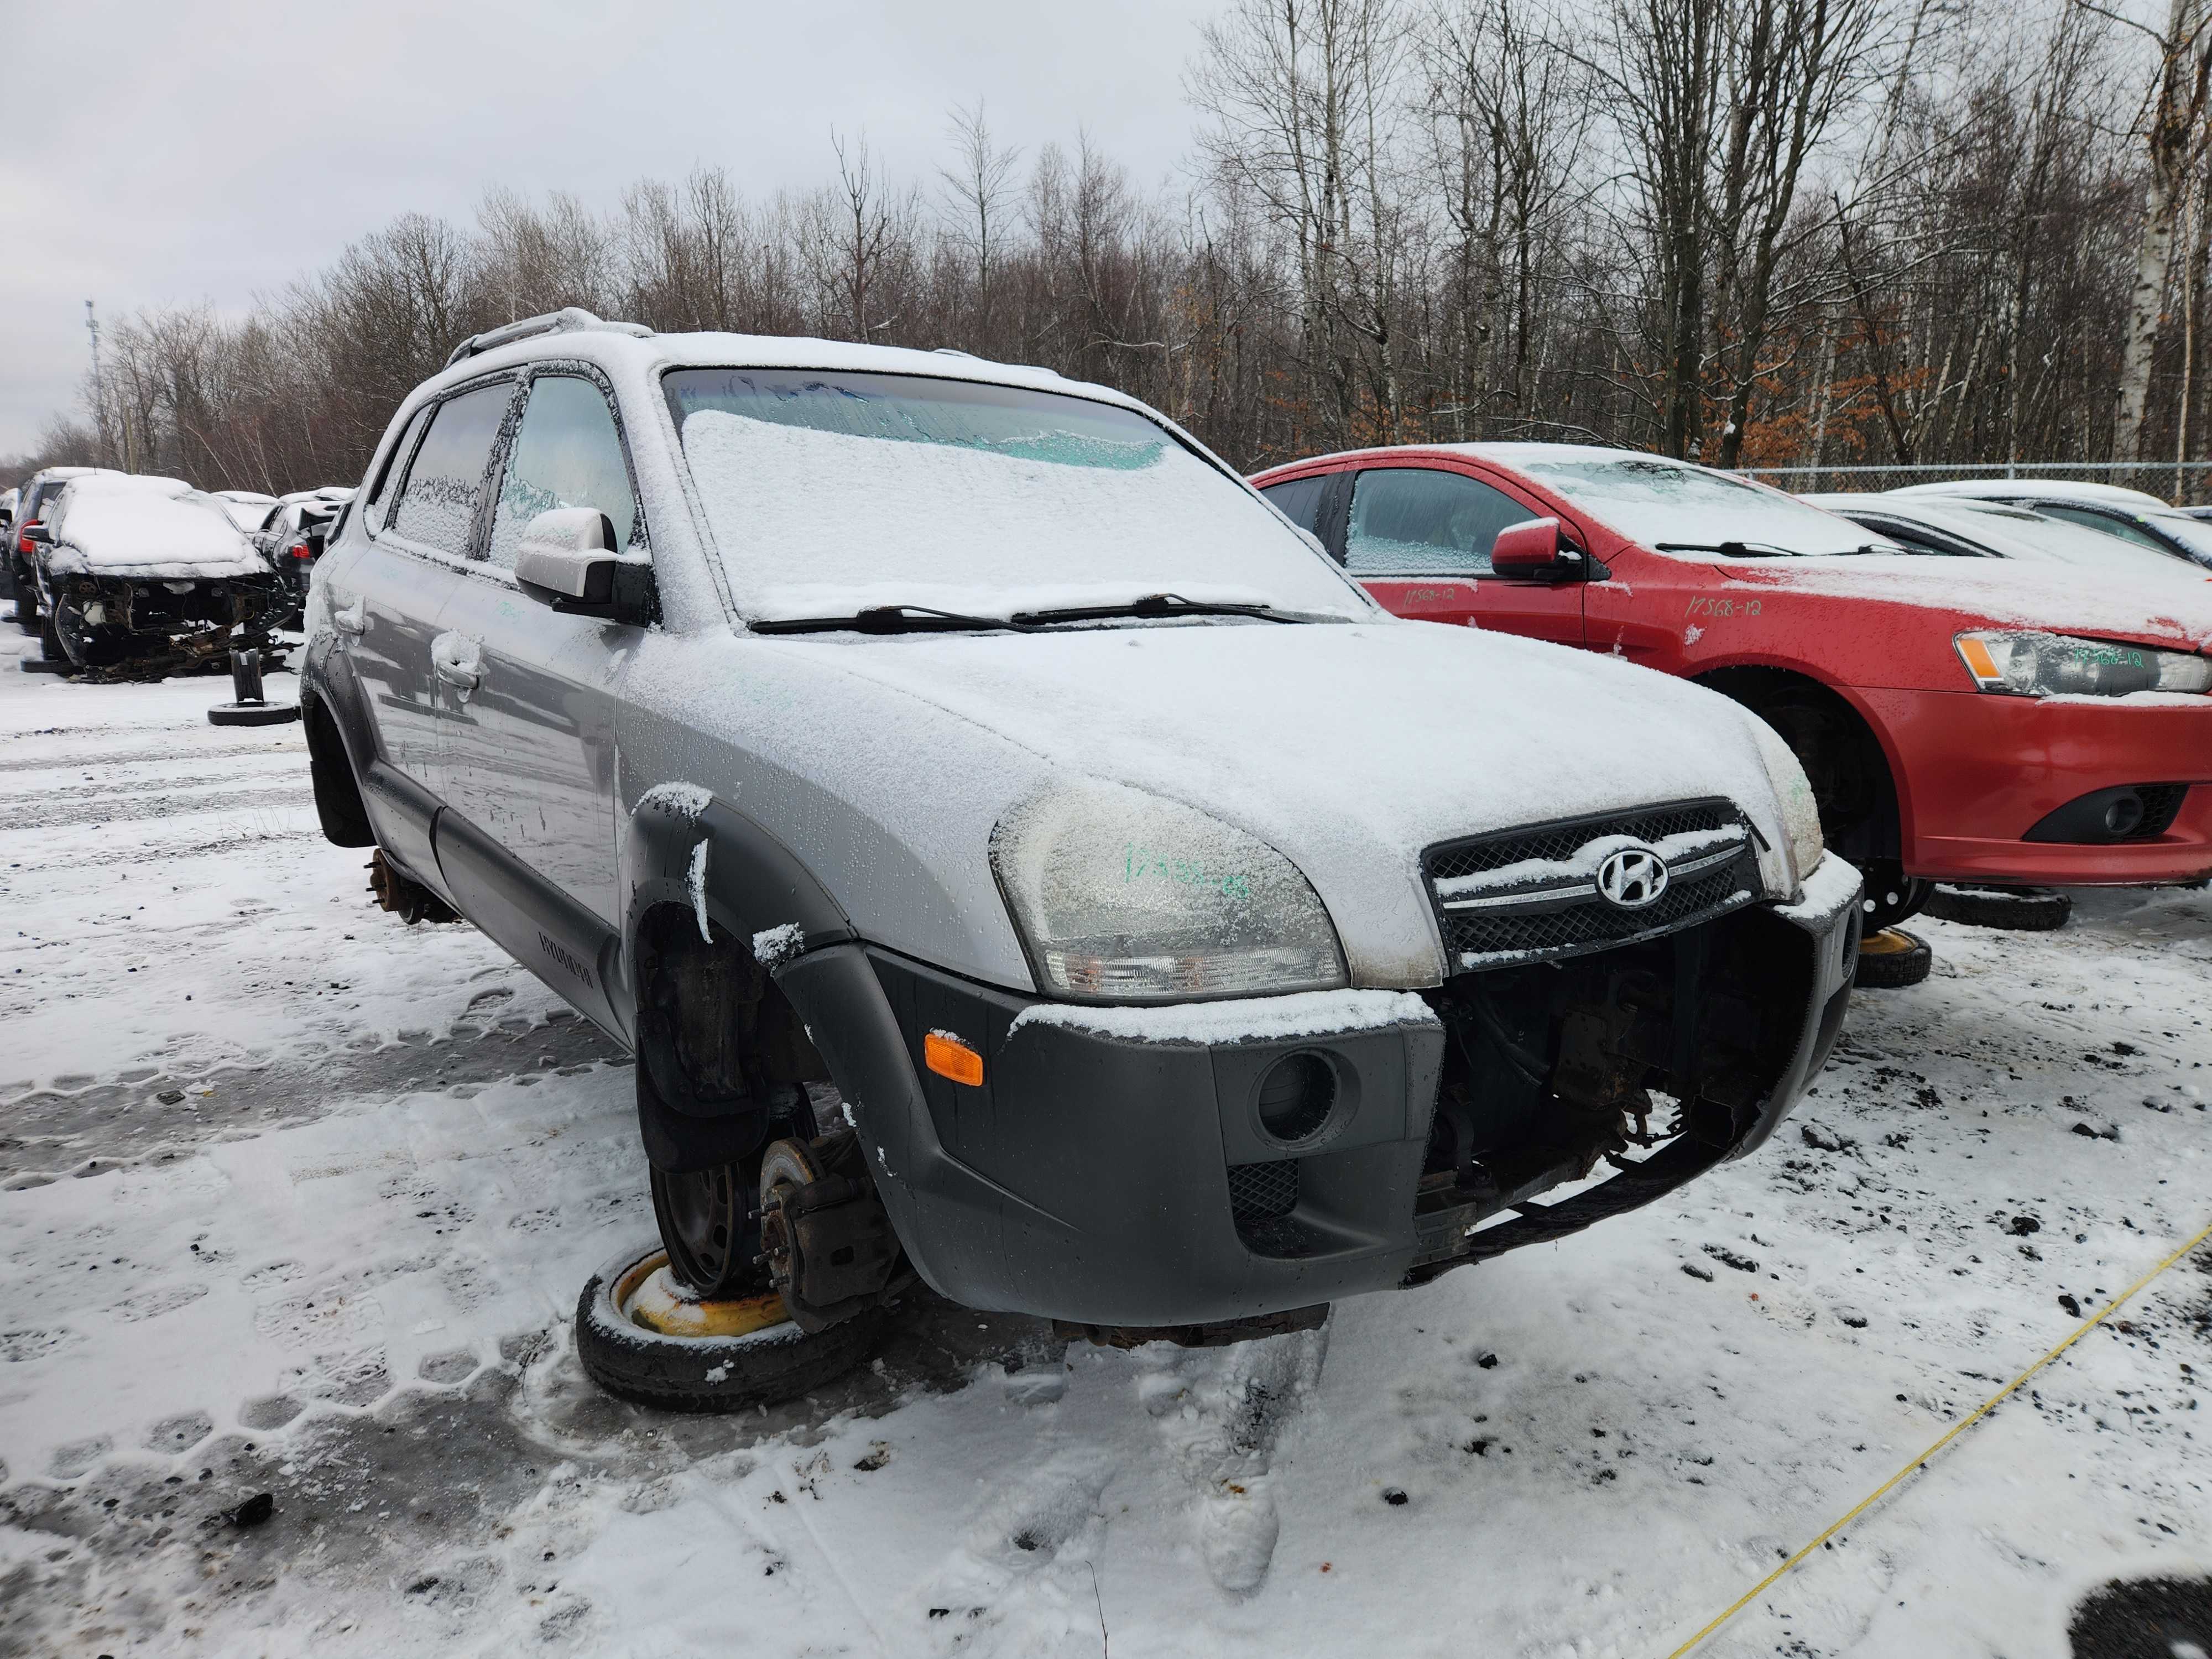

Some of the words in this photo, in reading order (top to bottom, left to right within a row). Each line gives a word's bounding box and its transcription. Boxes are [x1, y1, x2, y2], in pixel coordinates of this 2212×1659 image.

[1404, 588, 1454, 606] 17568-12
[1684, 596, 1761, 617] 17568-12
[538, 931, 593, 989] HYUNDAI
